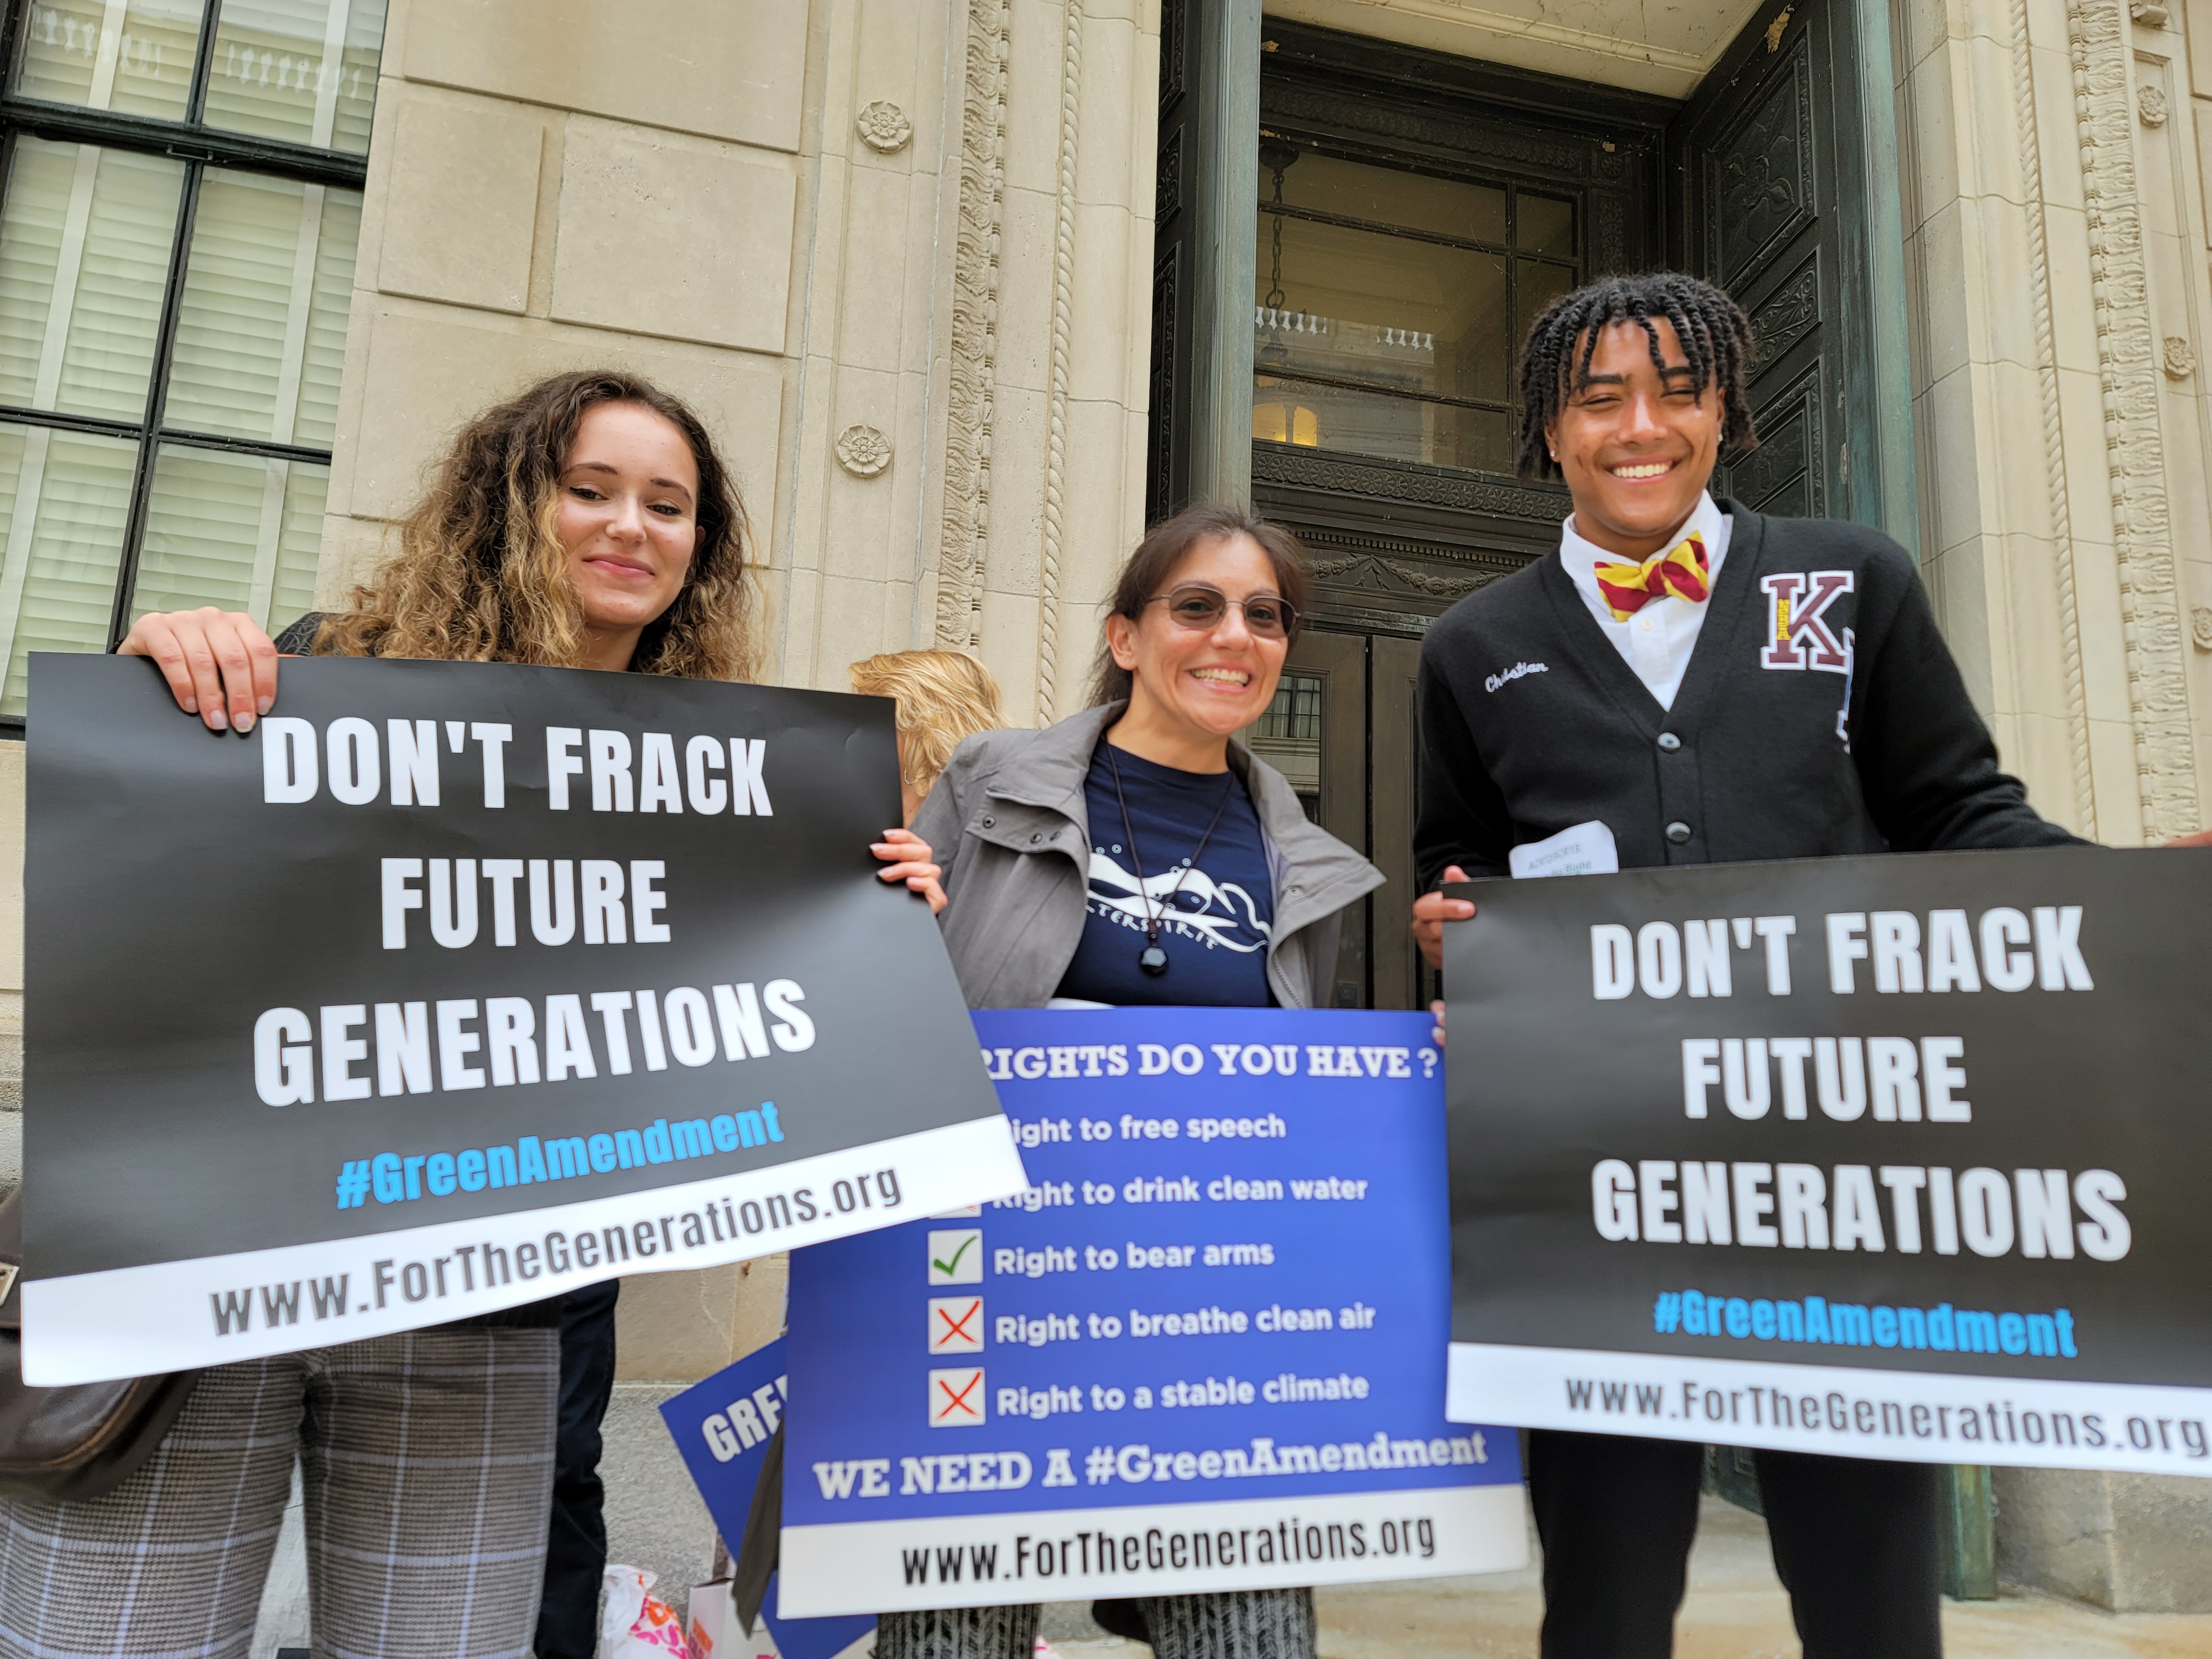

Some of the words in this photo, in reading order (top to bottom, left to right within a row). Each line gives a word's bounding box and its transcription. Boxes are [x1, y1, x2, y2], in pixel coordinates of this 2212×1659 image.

[1485, 661, 1549, 692] Christian
[262, 717, 512, 808] DON'T
[546, 727, 773, 816] FRACK
[382, 858, 671, 949] FUTURE
[1591, 916, 1796, 1000] DON'T
[1826, 906, 2094, 994] FRACK
[254, 979, 816, 1107] GENERATIONS
[1138, 1044, 1204, 1075] DO
[1211, 1044, 1298, 1076] YOU
[1306, 1045, 1411, 1078] HAVE
[1682, 1037, 1971, 1121] FUTURE
[336, 1102, 784, 1209] #GreenAmendment
[1012, 1117, 1072, 1148] ight
[1079, 1118, 1112, 1141] to
[1120, 1114, 1179, 1139] free
[1187, 1113, 1286, 1142] speech
[1082, 1181, 1115, 1204] to
[1124, 1176, 1200, 1203] drink
[1207, 1176, 1283, 1201] clean
[1290, 1177, 1368, 1200] water
[1593, 1160, 2131, 1260] GENERATIONS
[210, 1166, 902, 1336] www.ForTheGenerations.org
[995, 1246, 1077, 1278] Right
[1085, 1246, 1119, 1270] to
[1126, 1243, 1195, 1269] bear
[1203, 1244, 1275, 1266] arms
[996, 1314, 1079, 1347] Right
[1088, 1314, 1121, 1338] to
[1130, 1307, 1249, 1337] breathe
[1255, 1305, 1333, 1332] clean
[1339, 1303, 1376, 1329] air
[1653, 1290, 2077, 1358] #GreenAmendment
[702, 1374, 788, 1463] GRE
[998, 1386, 1082, 1420] Right
[1091, 1386, 1126, 1411] to
[1134, 1386, 1153, 1409] a
[1161, 1378, 1255, 1408] stable
[1262, 1373, 1369, 1403] climate
[1566, 1379, 2208, 1458] www.ForTheGenerations.org
[813, 1459, 890, 1500] WE
[900, 1452, 1032, 1494] NEED
[1042, 1449, 1077, 1487] A
[1086, 1431, 1488, 1485] #GreenAmendment
[902, 1517, 1436, 1586] www.ForTheGenerations.org
